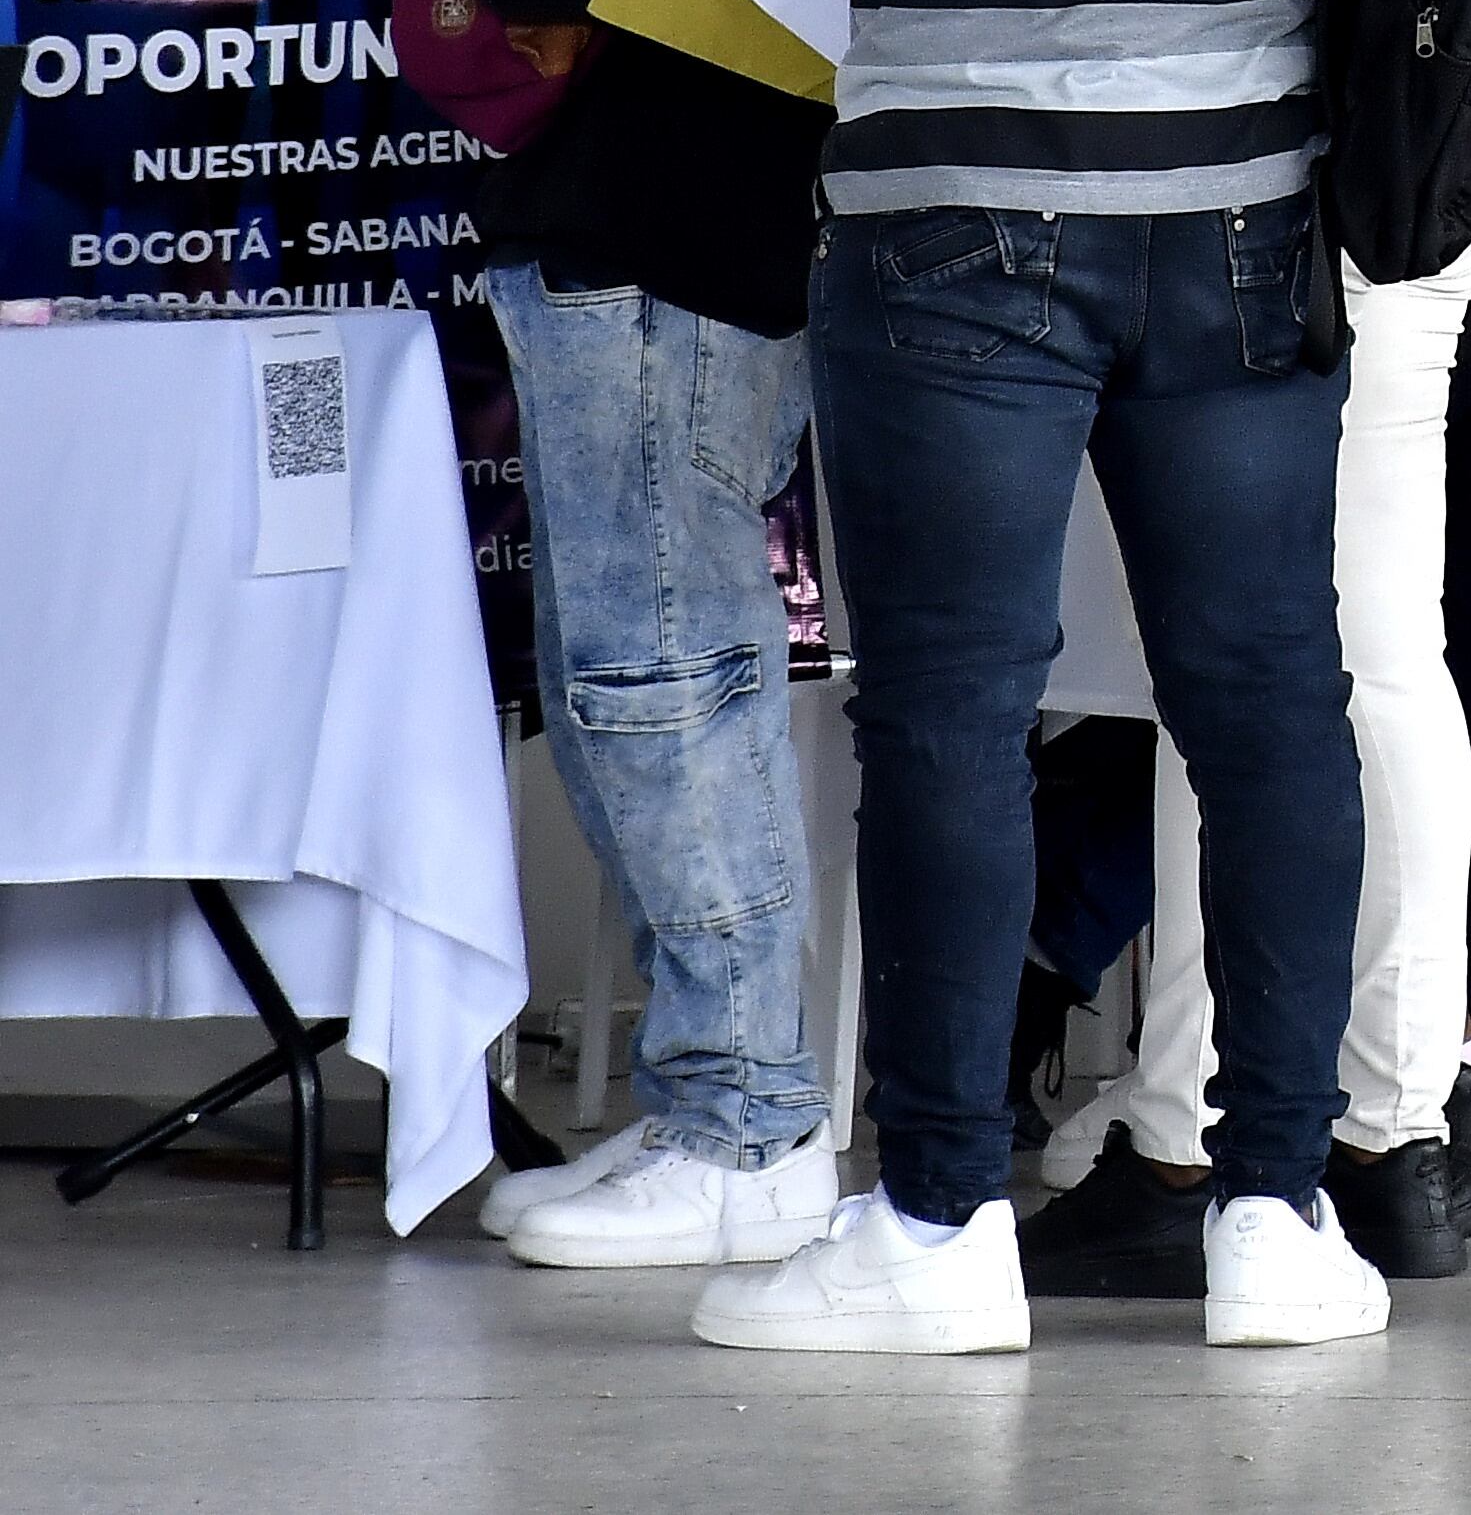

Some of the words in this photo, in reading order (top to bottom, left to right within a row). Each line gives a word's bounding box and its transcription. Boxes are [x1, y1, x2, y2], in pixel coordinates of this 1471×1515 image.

[133, 136, 361, 183] NUESTRAS
[69, 217, 273, 268] BOGOTÁ
[307, 212, 482, 256] SABANA
